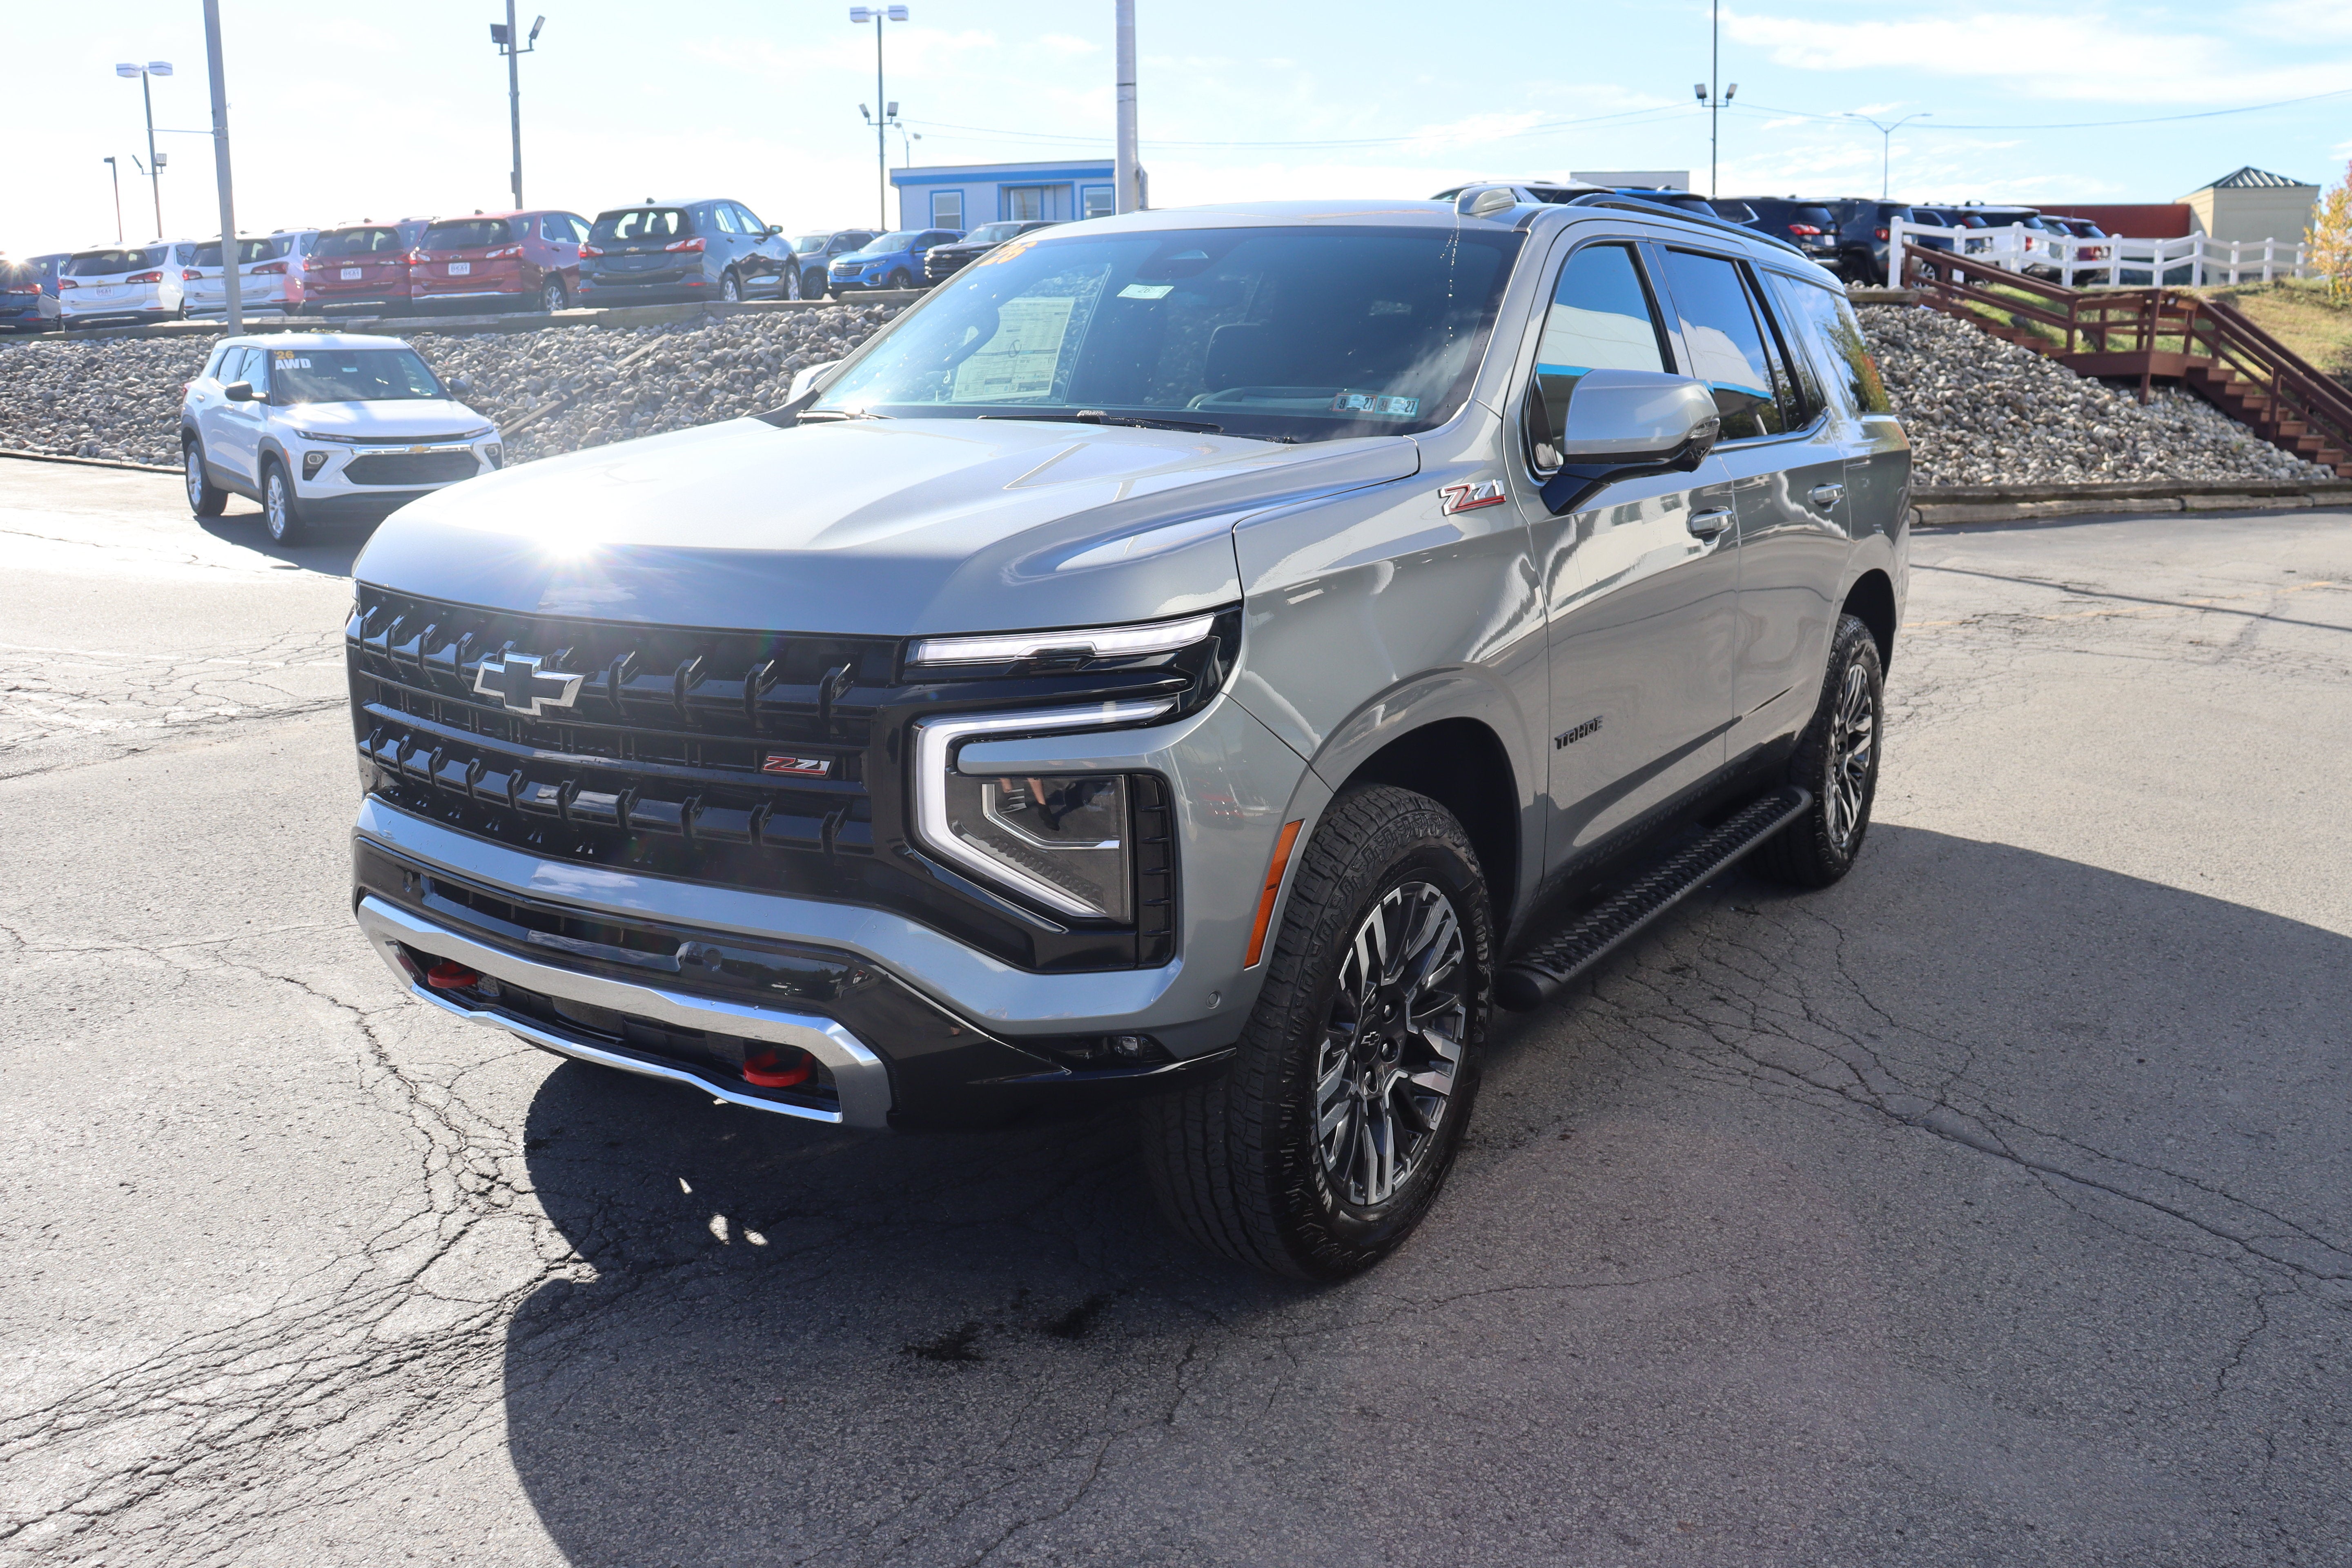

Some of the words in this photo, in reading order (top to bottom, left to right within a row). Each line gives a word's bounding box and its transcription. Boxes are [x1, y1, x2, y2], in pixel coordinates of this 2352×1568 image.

[275, 358, 312, 370] AWD
[1363, 397, 1374, 411] 27
[1405, 400, 1416, 414] 27
[1439, 479, 1506, 516] Z71
[1554, 715, 1603, 750] TAHOE
[763, 755, 831, 775] Z71
